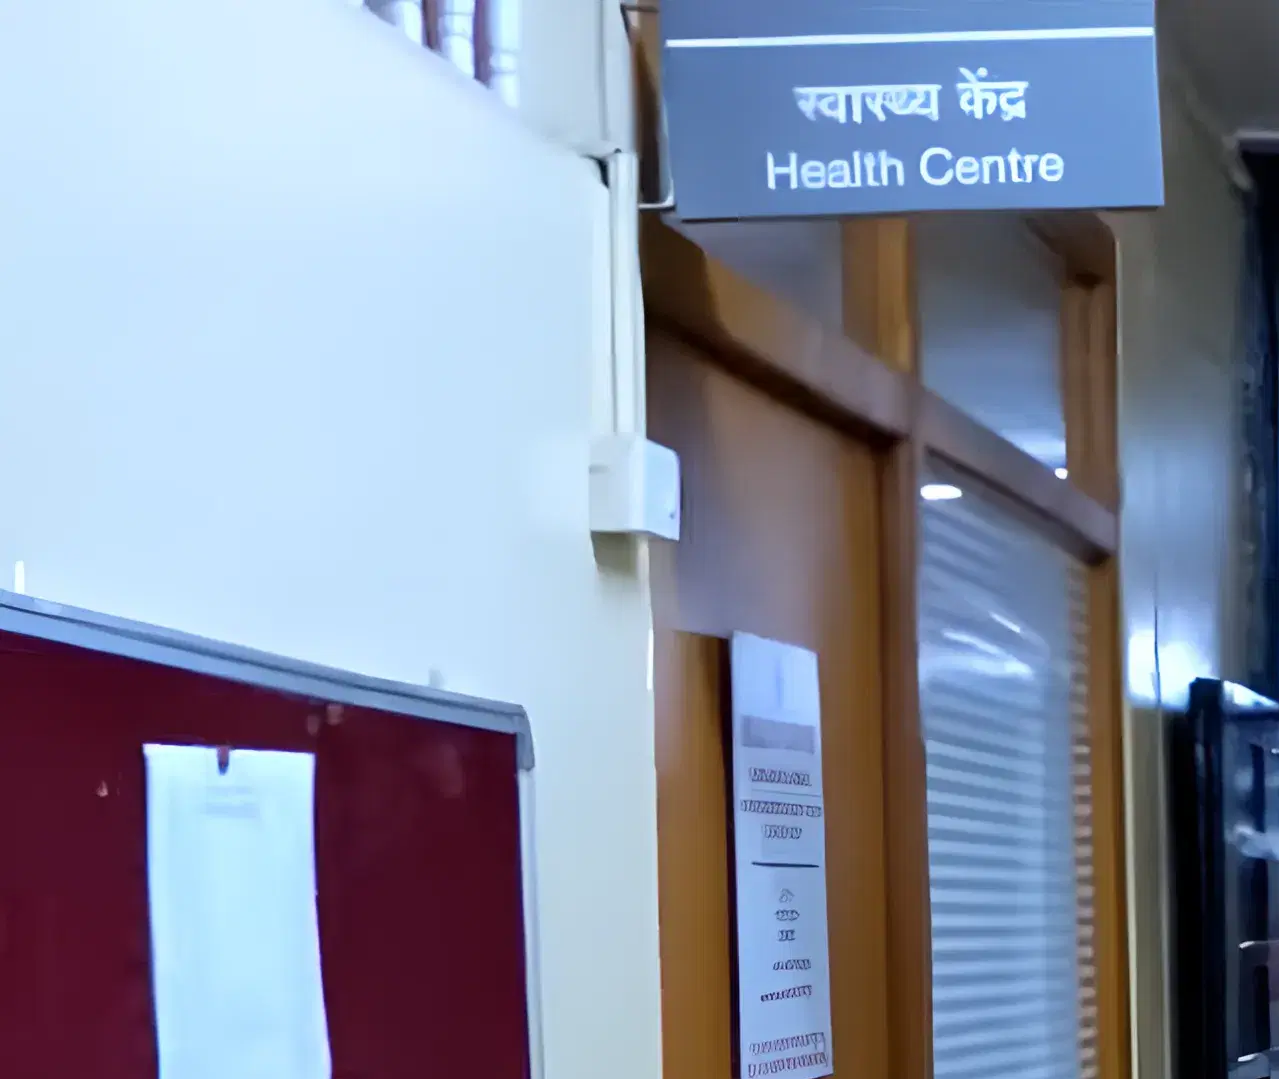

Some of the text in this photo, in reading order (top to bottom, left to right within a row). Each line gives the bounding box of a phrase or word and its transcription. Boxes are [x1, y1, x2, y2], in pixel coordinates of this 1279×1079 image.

[793, 67, 1030, 124] स्वास्थ्य केंद्र
[766, 146, 1065, 191] Health Centre
